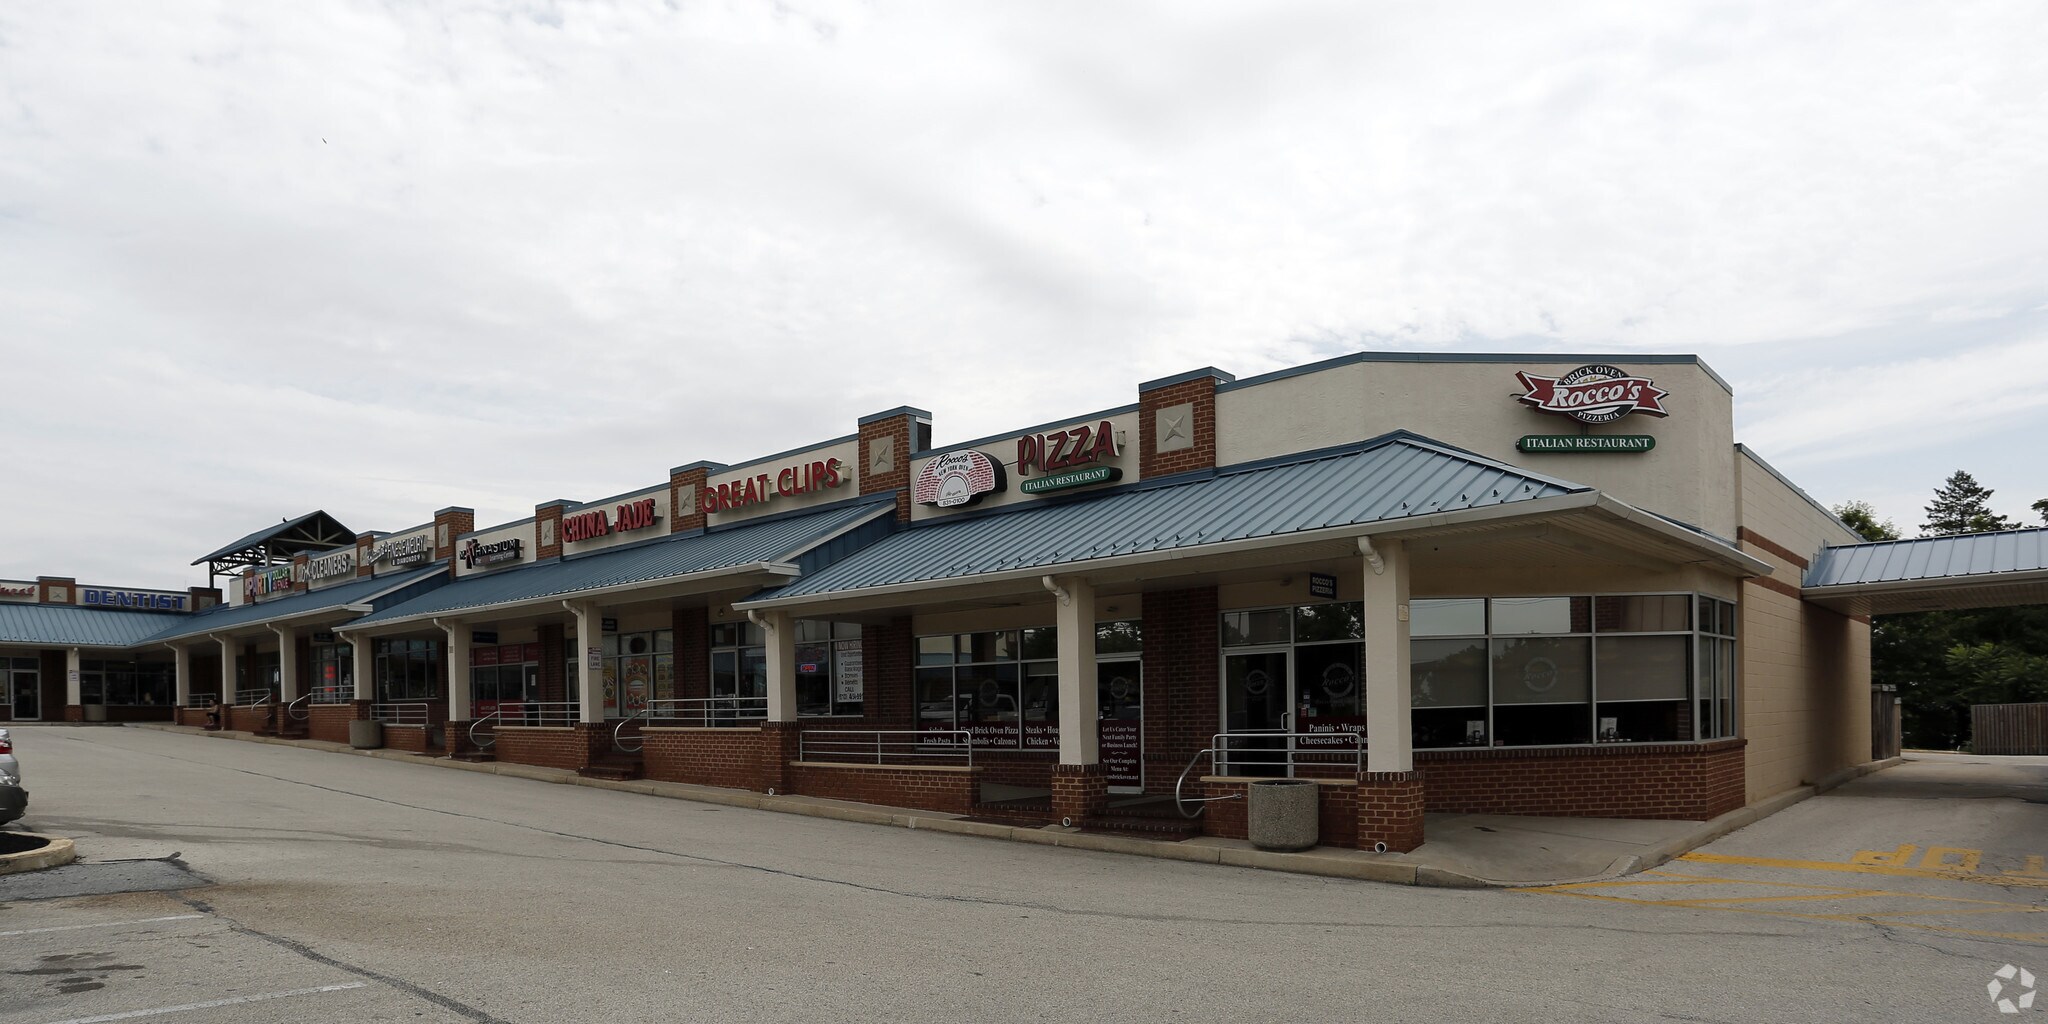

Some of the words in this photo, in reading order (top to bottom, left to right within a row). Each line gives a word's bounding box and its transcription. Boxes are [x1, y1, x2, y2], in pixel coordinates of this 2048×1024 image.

[1564, 366, 1593, 386] BRICK
[1595, 366, 1625, 379] OVEN
[1577, 411, 1620, 423] PIZZERIA
[1017, 420, 1117, 476] PIZZA
[1526, 438, 1573, 449] ITALIAN
[1576, 438, 1650, 449] RESTAURANT
[936, 453, 969, 469] Rocco's
[700, 474, 769, 514] GREAT
[777, 457, 841, 497] CLIPS
[1024, 477, 1055, 491] ITALIAN
[1056, 469, 1107, 486] RESTAURANT
[562, 510, 609, 543] CHINA
[613, 498, 656, 533] JADE
[459, 539, 517, 568] MATHNASIUM
[312, 554, 348, 580] CLEANERS
[245, 571, 272, 597] PARTY
[84, 589, 187, 610] DENTIST
[974, 726, 989, 735] Brick
[990, 726, 1004, 735] Oven
[1005, 726, 1019, 735] Pizza
[1025, 726, 1043, 735] Steaks
[1309, 723, 1335, 733] Paninis
[1341, 723, 1366, 734] Wraps
[962, 737, 989, 746] Stombolis
[993, 737, 1017, 746] Calzones
[1026, 737, 1049, 746] Chicken
[1300, 736, 1344, 745] Cheesecakes
